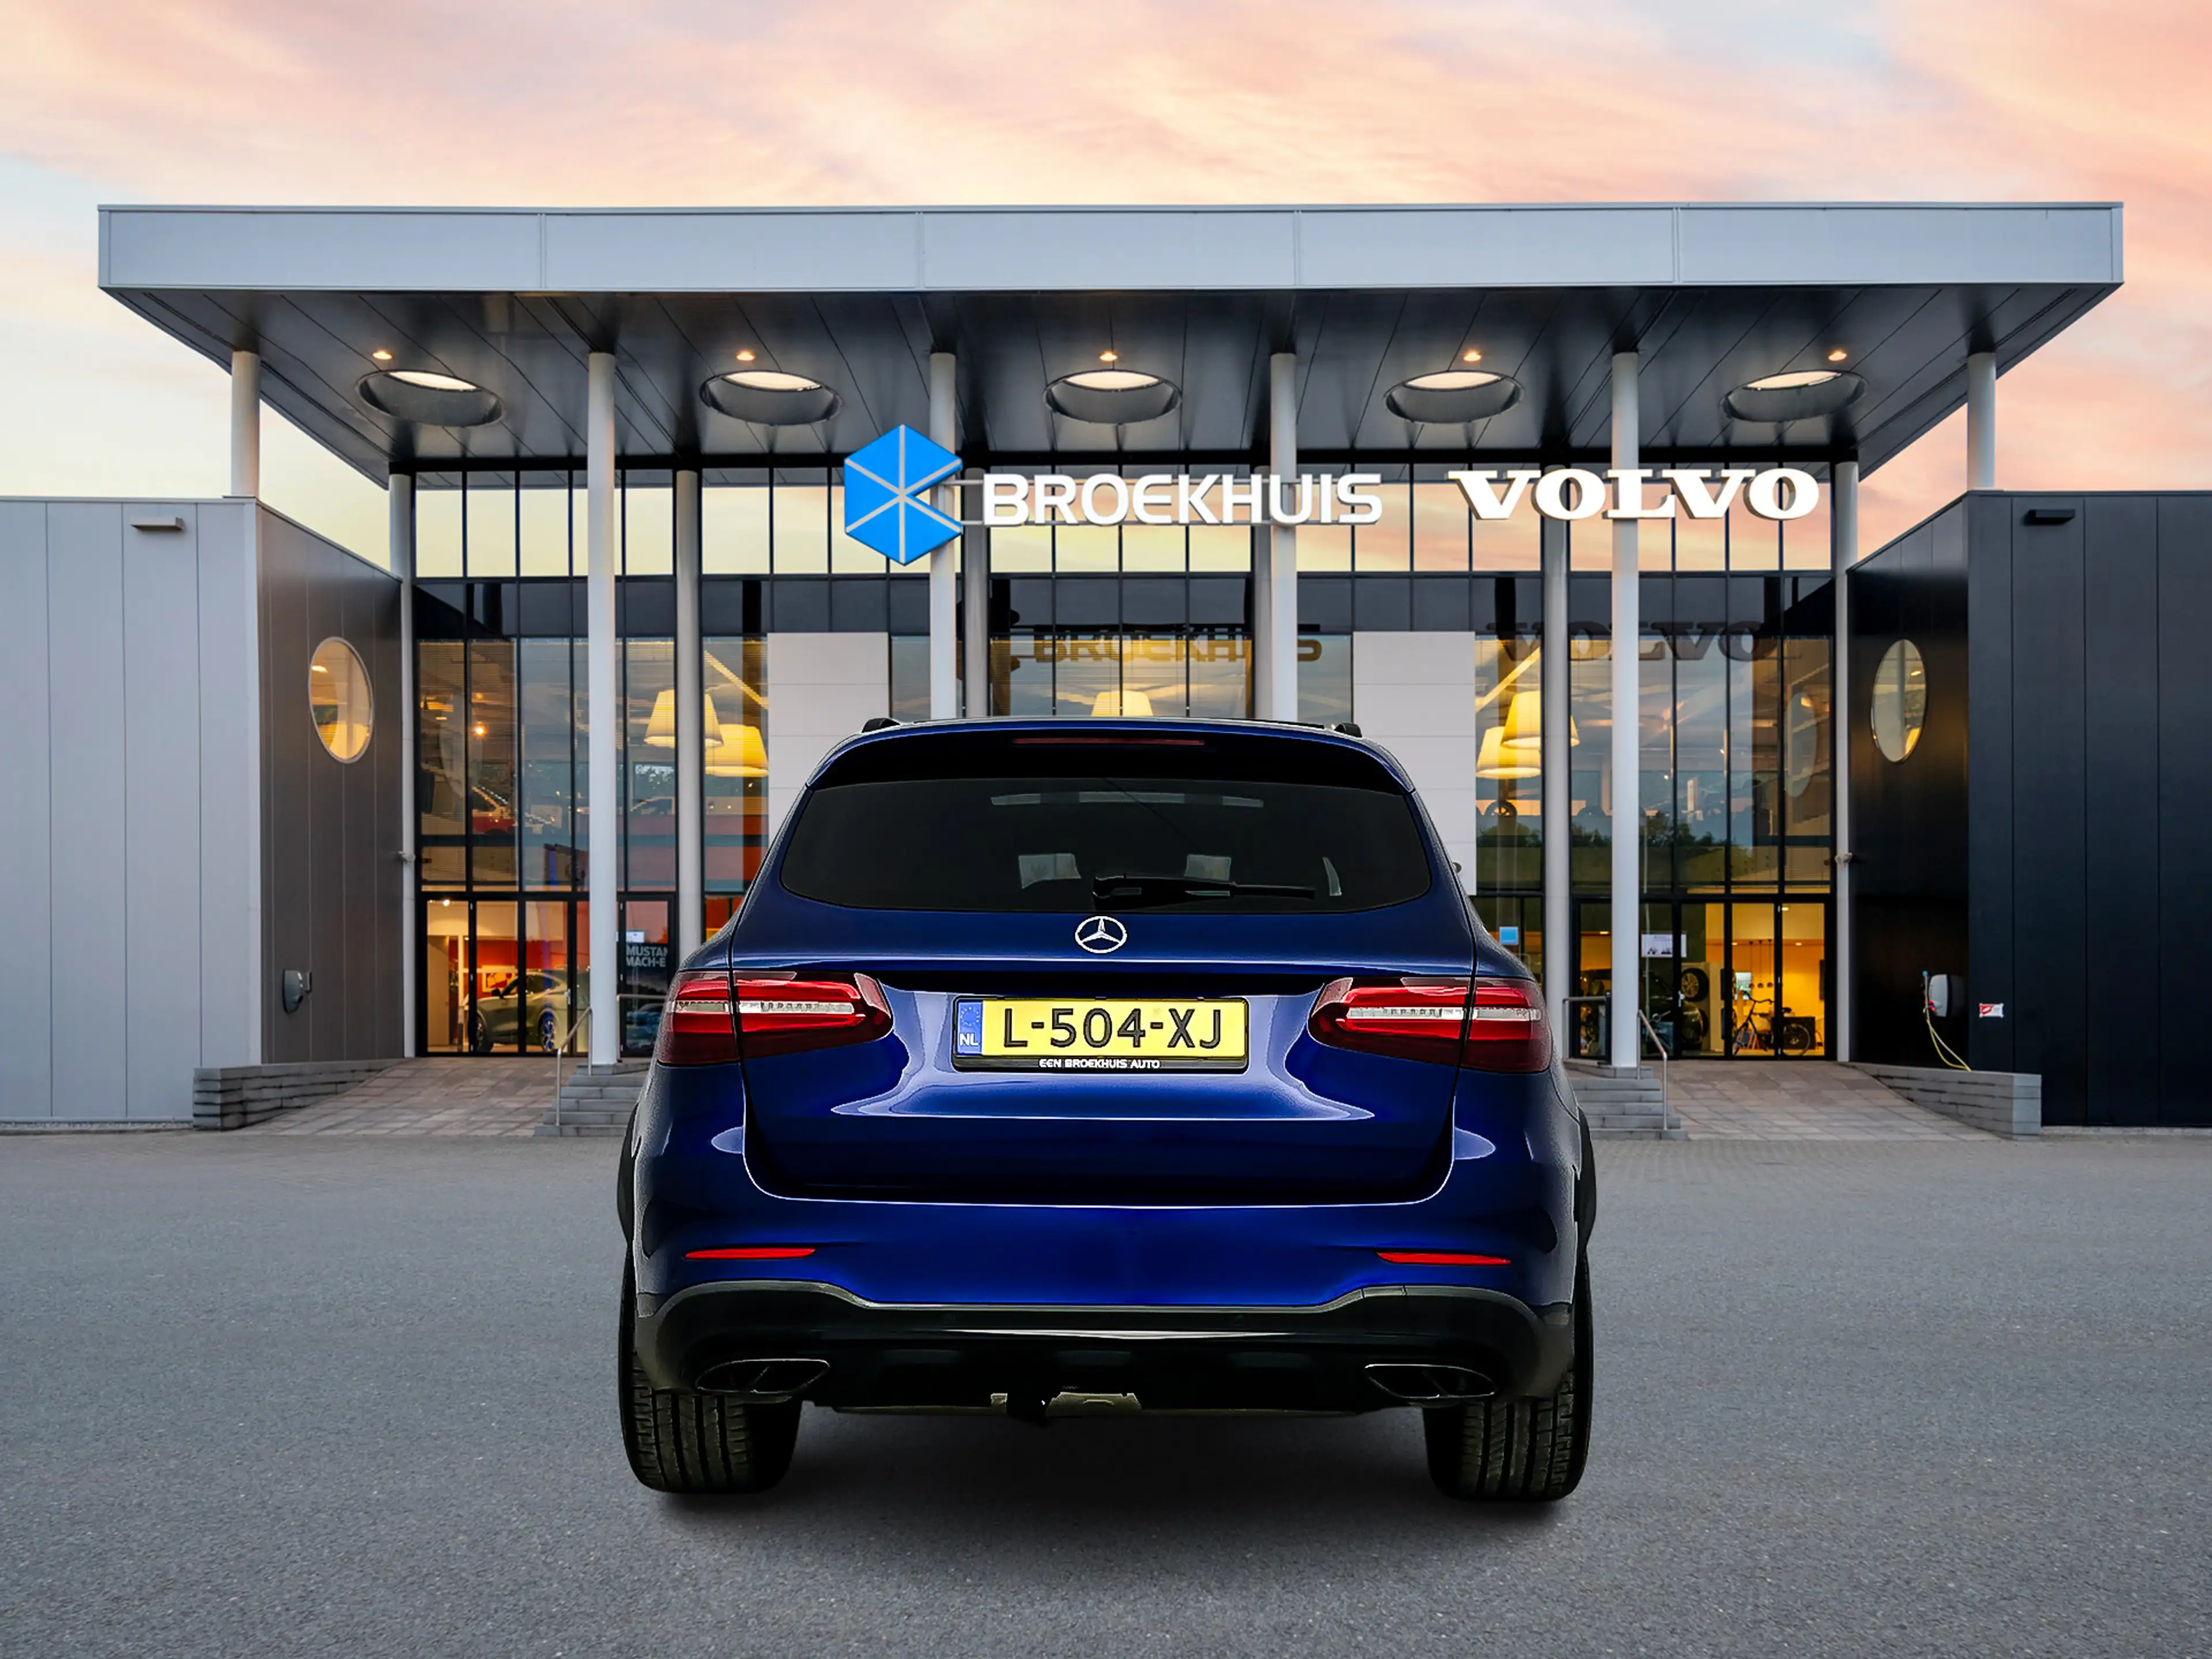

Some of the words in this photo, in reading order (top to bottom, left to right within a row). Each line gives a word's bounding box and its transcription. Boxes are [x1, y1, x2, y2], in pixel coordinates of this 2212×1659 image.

[983, 473, 1382, 525] BROEKHUIS
[1445, 468, 1820, 520] VOLVO
[626, 956, 666, 968] MACH-E
[959, 1033, 979, 1046] NL
[1003, 1008, 1222, 1048] L-504-XJ
[1039, 1058, 1062, 1068] EEN
[1065, 1059, 1127, 1069] BROEKHUIS
[1130, 1059, 1160, 1069] AUTO
